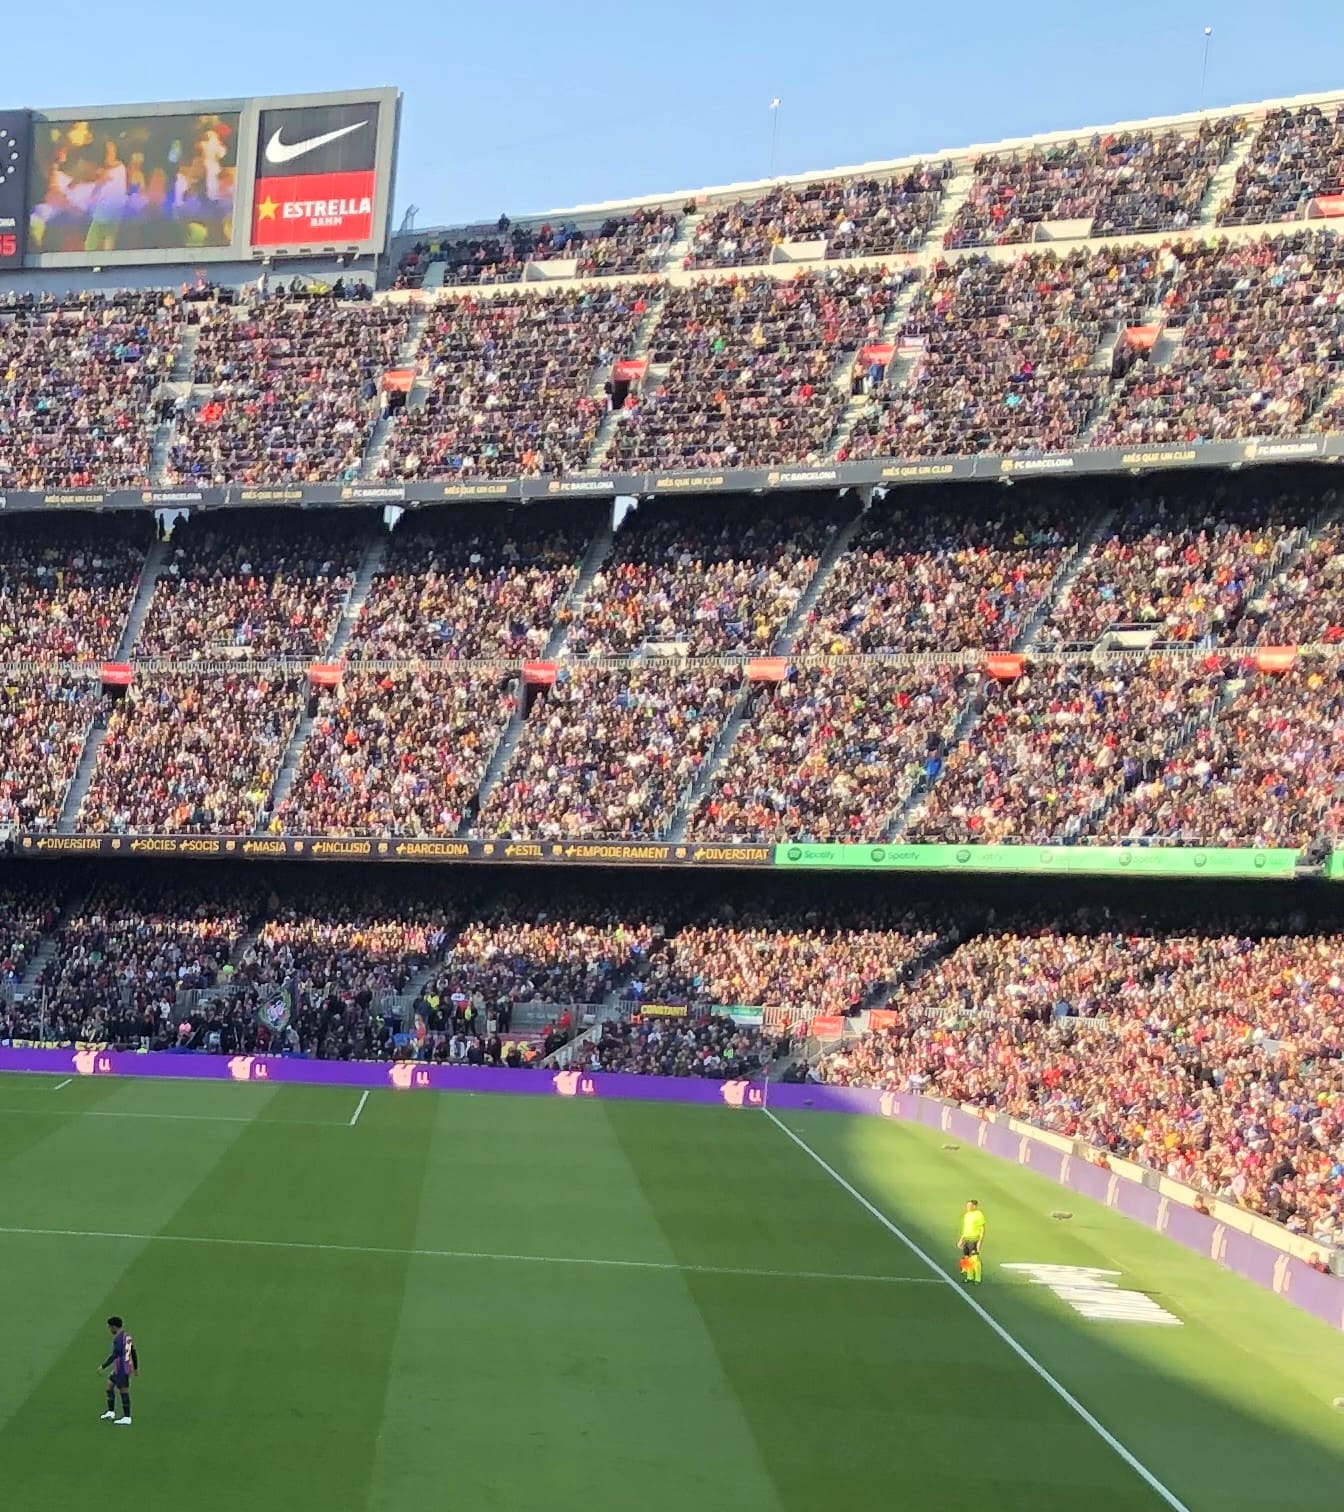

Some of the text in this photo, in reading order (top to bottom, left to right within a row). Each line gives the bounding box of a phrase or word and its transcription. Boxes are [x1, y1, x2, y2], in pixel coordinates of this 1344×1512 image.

[283, 197, 371, 219] ESTRELLA
[1015, 458, 1074, 469] FC BARCELONA
[780, 470, 836, 481] FC BARCELONA
[560, 481, 614, 491] FC BARCELONA
[163, 492, 202, 501] BARCELONA
[353, 488, 405, 497] FC BARCELONA
